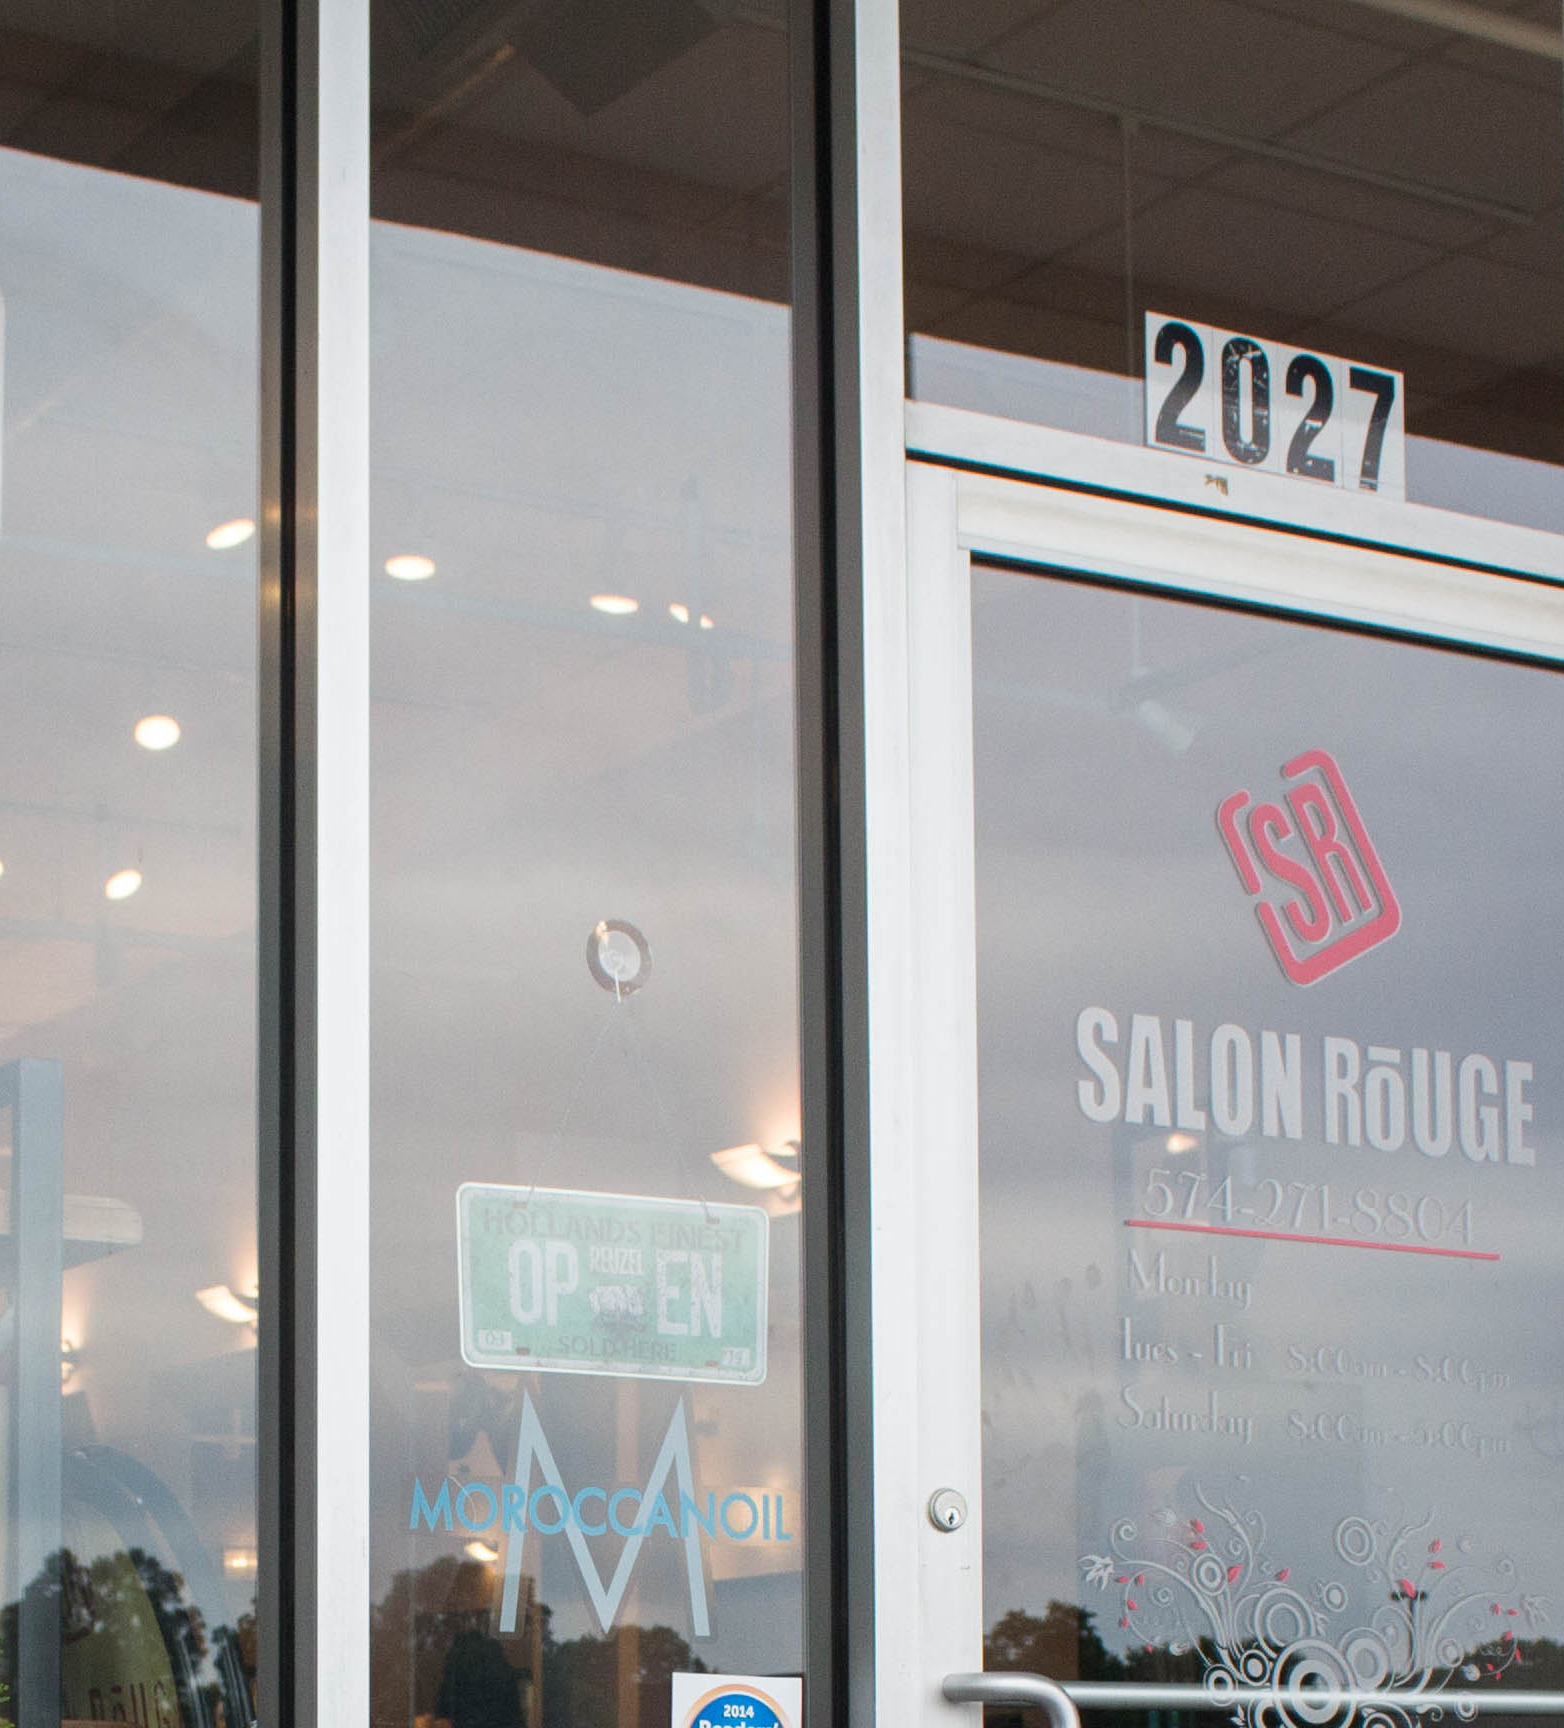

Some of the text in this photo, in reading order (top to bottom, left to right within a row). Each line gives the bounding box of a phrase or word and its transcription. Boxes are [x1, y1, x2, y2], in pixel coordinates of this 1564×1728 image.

[1154, 321, 1395, 492] 2027
[1076, 1006, 1302, 1140] SALON
[483, 1206, 643, 1244] HOLLANDS
[1143, 1168, 1474, 1245] 574-271-8804
[1127, 1248, 1252, 1311] Monday
[558, 1334, 616, 1355] SOLD
[1121, 1316, 1178, 1363] Tues
[1214, 1323, 1252, 1369] Fri
[1117, 1384, 1253, 1445] Saturday
[409, 1477, 792, 1543] MOROCCANOIL
[498, 1388, 711, 1637] M
[723, 1704, 755, 1719] 2014
